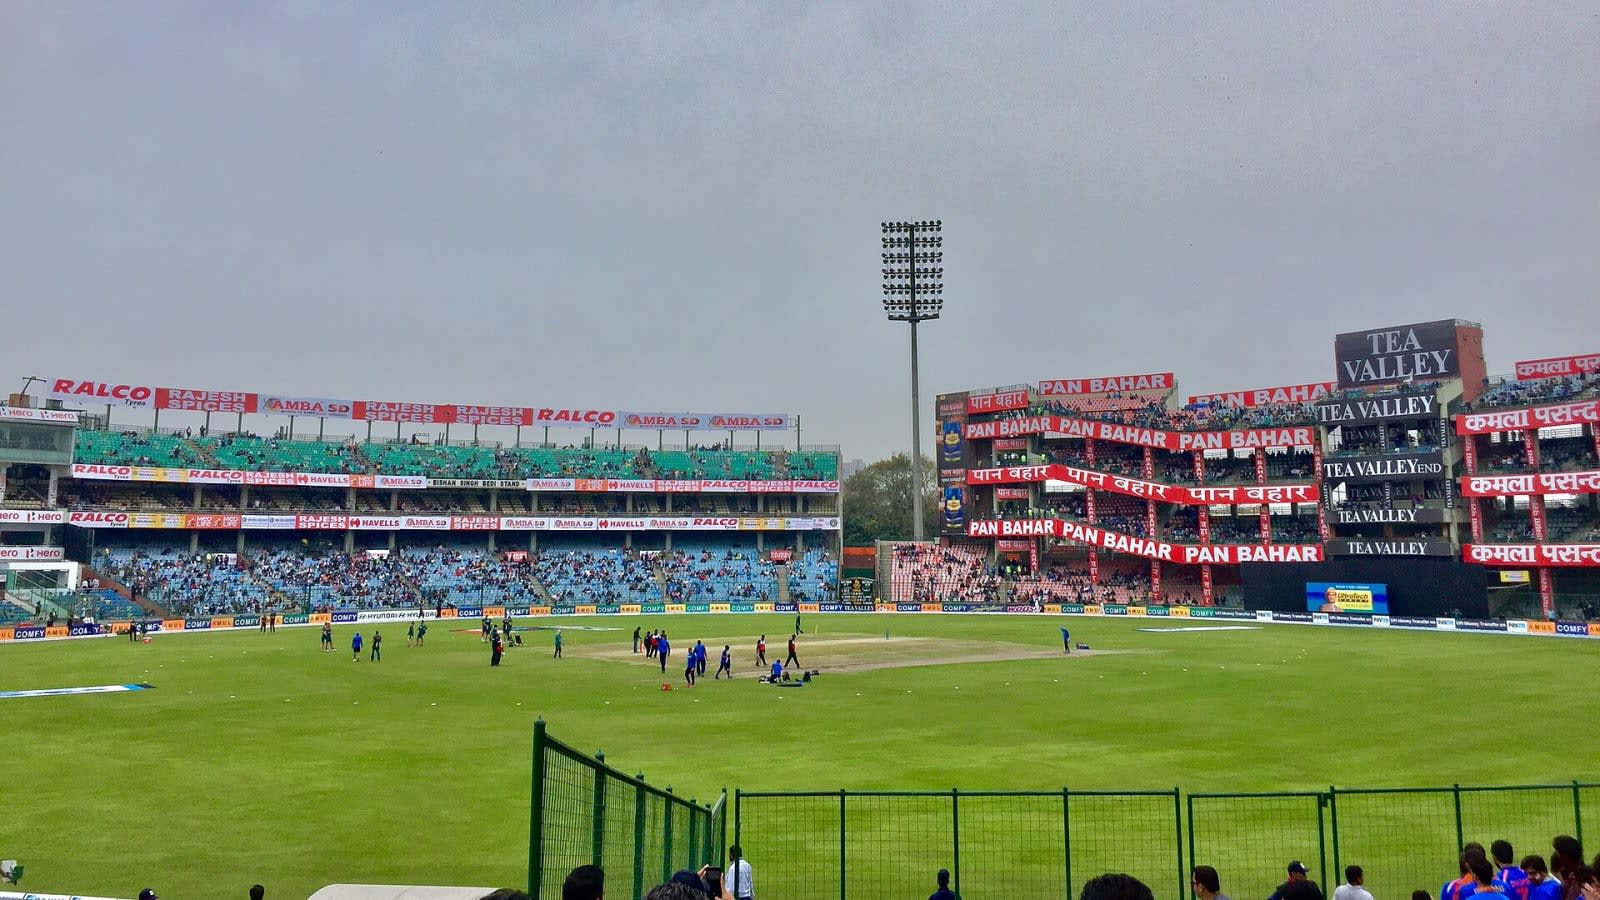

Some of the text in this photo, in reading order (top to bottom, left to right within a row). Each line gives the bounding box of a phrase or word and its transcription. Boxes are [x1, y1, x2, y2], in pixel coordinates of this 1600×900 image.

[1367, 328, 1423, 355] TEA
[1344, 349, 1451, 382] VALLEY
[1517, 360, 1571, 375] कमला
[53, 379, 151, 400] RALCO
[1040, 374, 1166, 394] PAN BAHAR
[168, 389, 246, 402] RAJESH
[971, 391, 1025, 409] पान बहार
[168, 400, 246, 412] SPICES
[272, 401, 323, 411] AMBA
[328, 404, 350, 413] SD
[365, 402, 434, 413] RAJESH
[457, 406, 523, 416] RAJESH
[1318, 395, 1435, 422] TEA VALLEY
[9, 409, 33, 417] Hero
[365, 411, 434, 422] SPICES
[537, 409, 615, 422] RALCO
[1465, 400, 1599, 431] कमला पसन्द
[456, 415, 523, 425] SPICES
[632, 415, 700, 425] AMBA SD
[717, 416, 783, 425] AMBA SD
[967, 416, 1051, 438] PAN BAHAR
[1060, 419, 1166, 447] PAN BAHAR
[1179, 428, 1310, 449] PAN BAHAR
[74, 465, 130, 475] RALCO
[189, 470, 241, 479] RALCO
[972, 468, 1004, 480] पान
[1007, 465, 1051, 480] बहार
[1324, 458, 1442, 478] TEA VALLEY END
[246, 471, 294, 479] RAJESH
[1066, 466, 1171, 499] पान बहार
[1470, 475, 1536, 493] कमला
[1187, 486, 1238, 500] पान
[1243, 485, 1312, 502] बहार
[0, 512, 19, 520] ero
[38, 512, 62, 521] Hero
[70, 512, 128, 522] RALCO
[693, 518, 738, 526] RALCO
[1338, 509, 1417, 523] TEA VALLEY
[970, 520, 1054, 535] PAN BAHAR
[1063, 522, 1171, 560] PAN BAHAR
[1347, 541, 1428, 554] TEA VALLEY
[0, 548, 18, 557] ero
[37, 549, 60, 557] Hero
[1186, 546, 1317, 562] PAN BAHAR
[1471, 545, 1536, 562] कमला
[1557, 624, 1587, 632] COMFY
